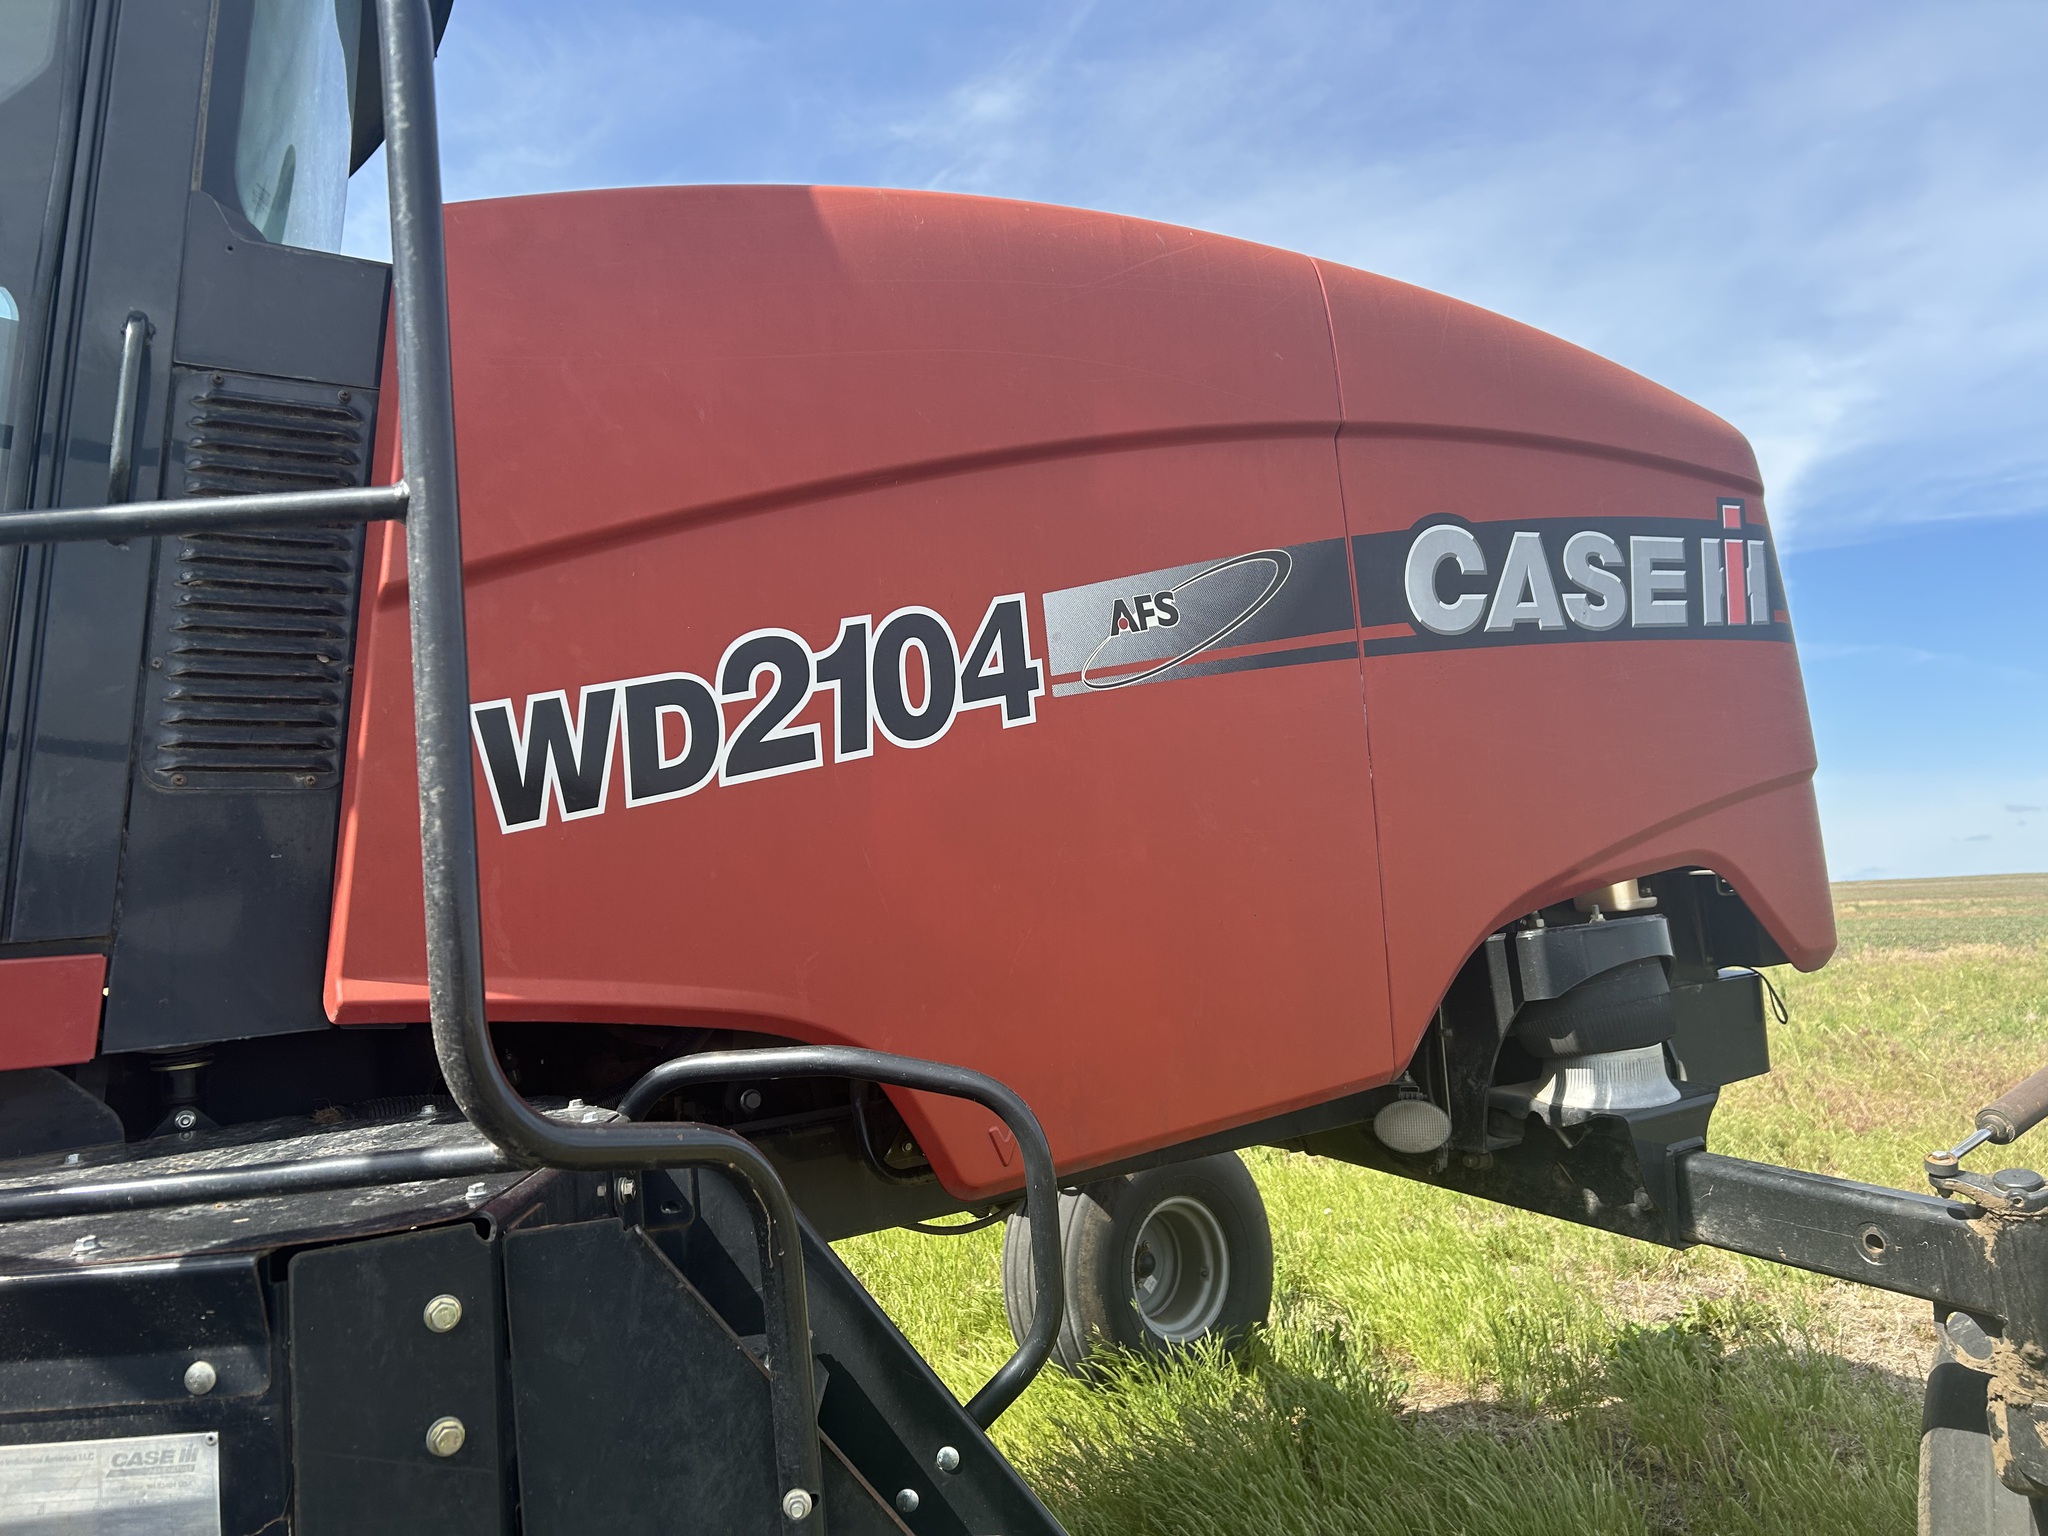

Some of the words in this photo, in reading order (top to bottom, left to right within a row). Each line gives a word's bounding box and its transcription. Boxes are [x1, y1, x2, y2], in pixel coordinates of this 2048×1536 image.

[1110, 590, 1180, 637] AFS
[1404, 524, 1688, 636] CASE
[470, 592, 1046, 834] WD2104
[110, 1449, 176, 1468] CASE
